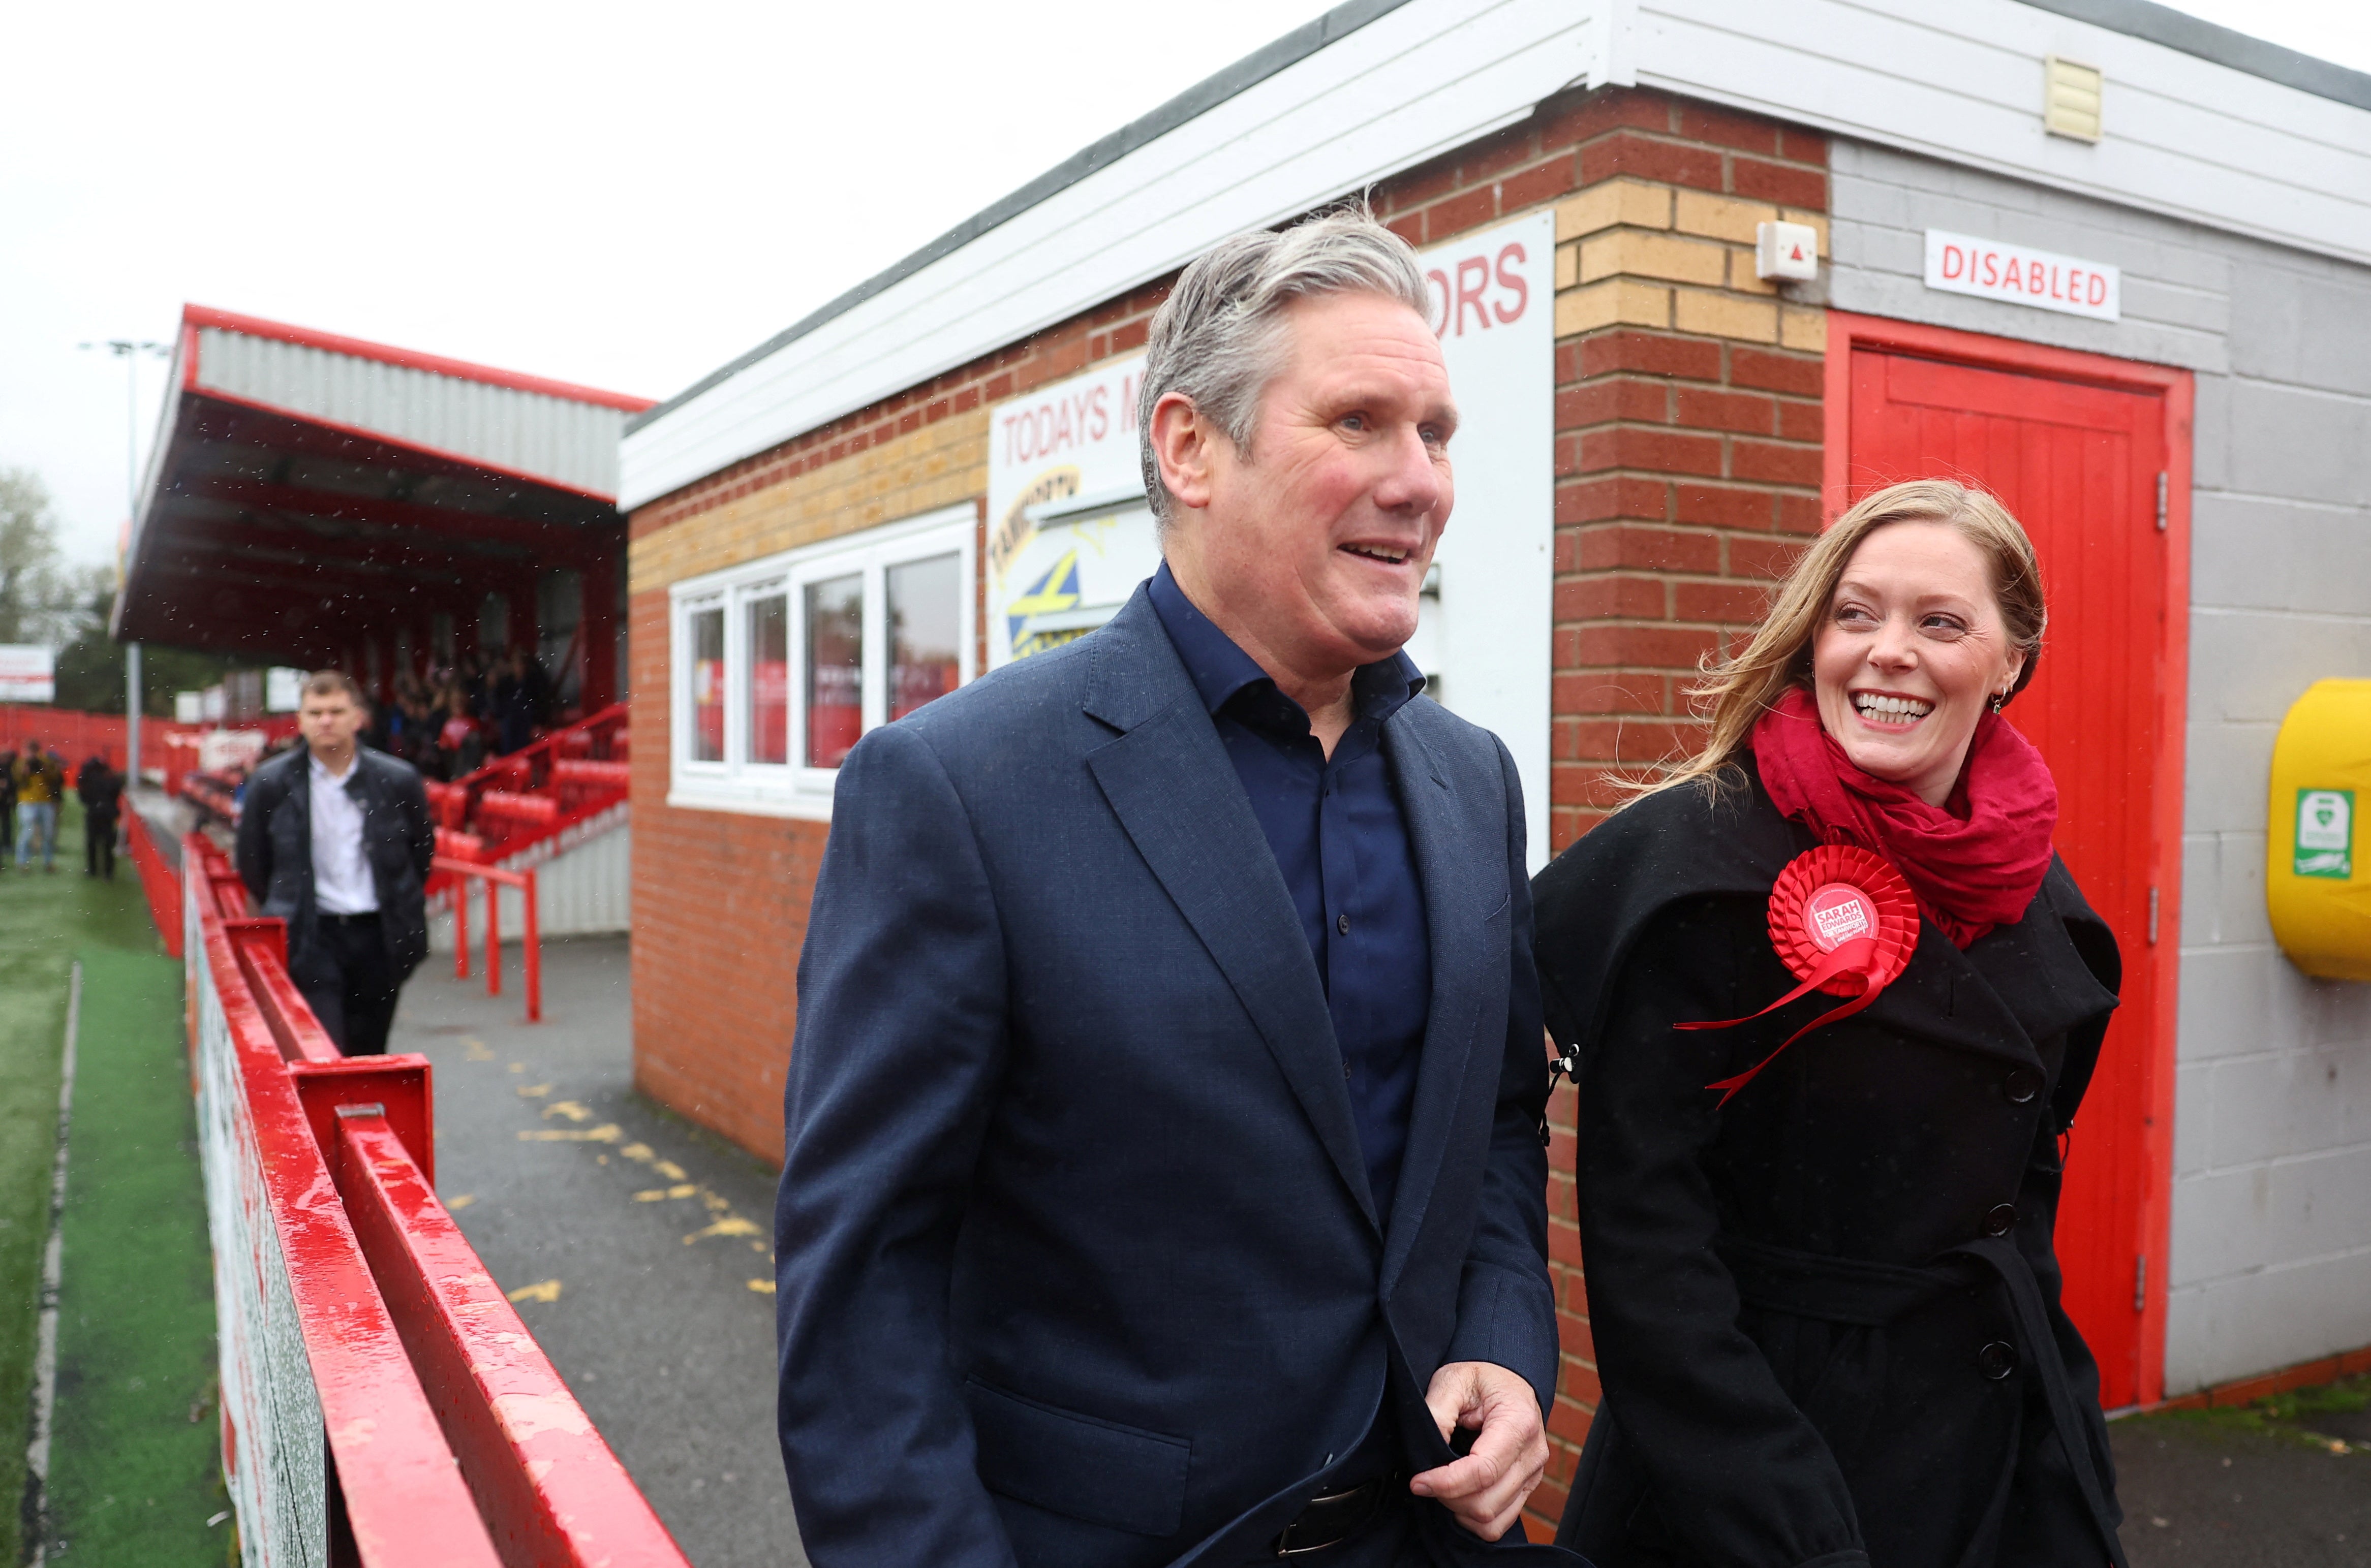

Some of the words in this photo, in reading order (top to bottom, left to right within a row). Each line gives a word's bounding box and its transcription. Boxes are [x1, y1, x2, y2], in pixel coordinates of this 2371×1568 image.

[1942, 244, 2106, 306] DISABLED
[1003, 385, 1108, 468] TODAYS
[1817, 901, 1859, 924] SARAH
[1821, 912, 1862, 931] EDWARDS
[1823, 930, 1835, 939] FOR
[1835, 919, 1868, 934] TAMWORTH
